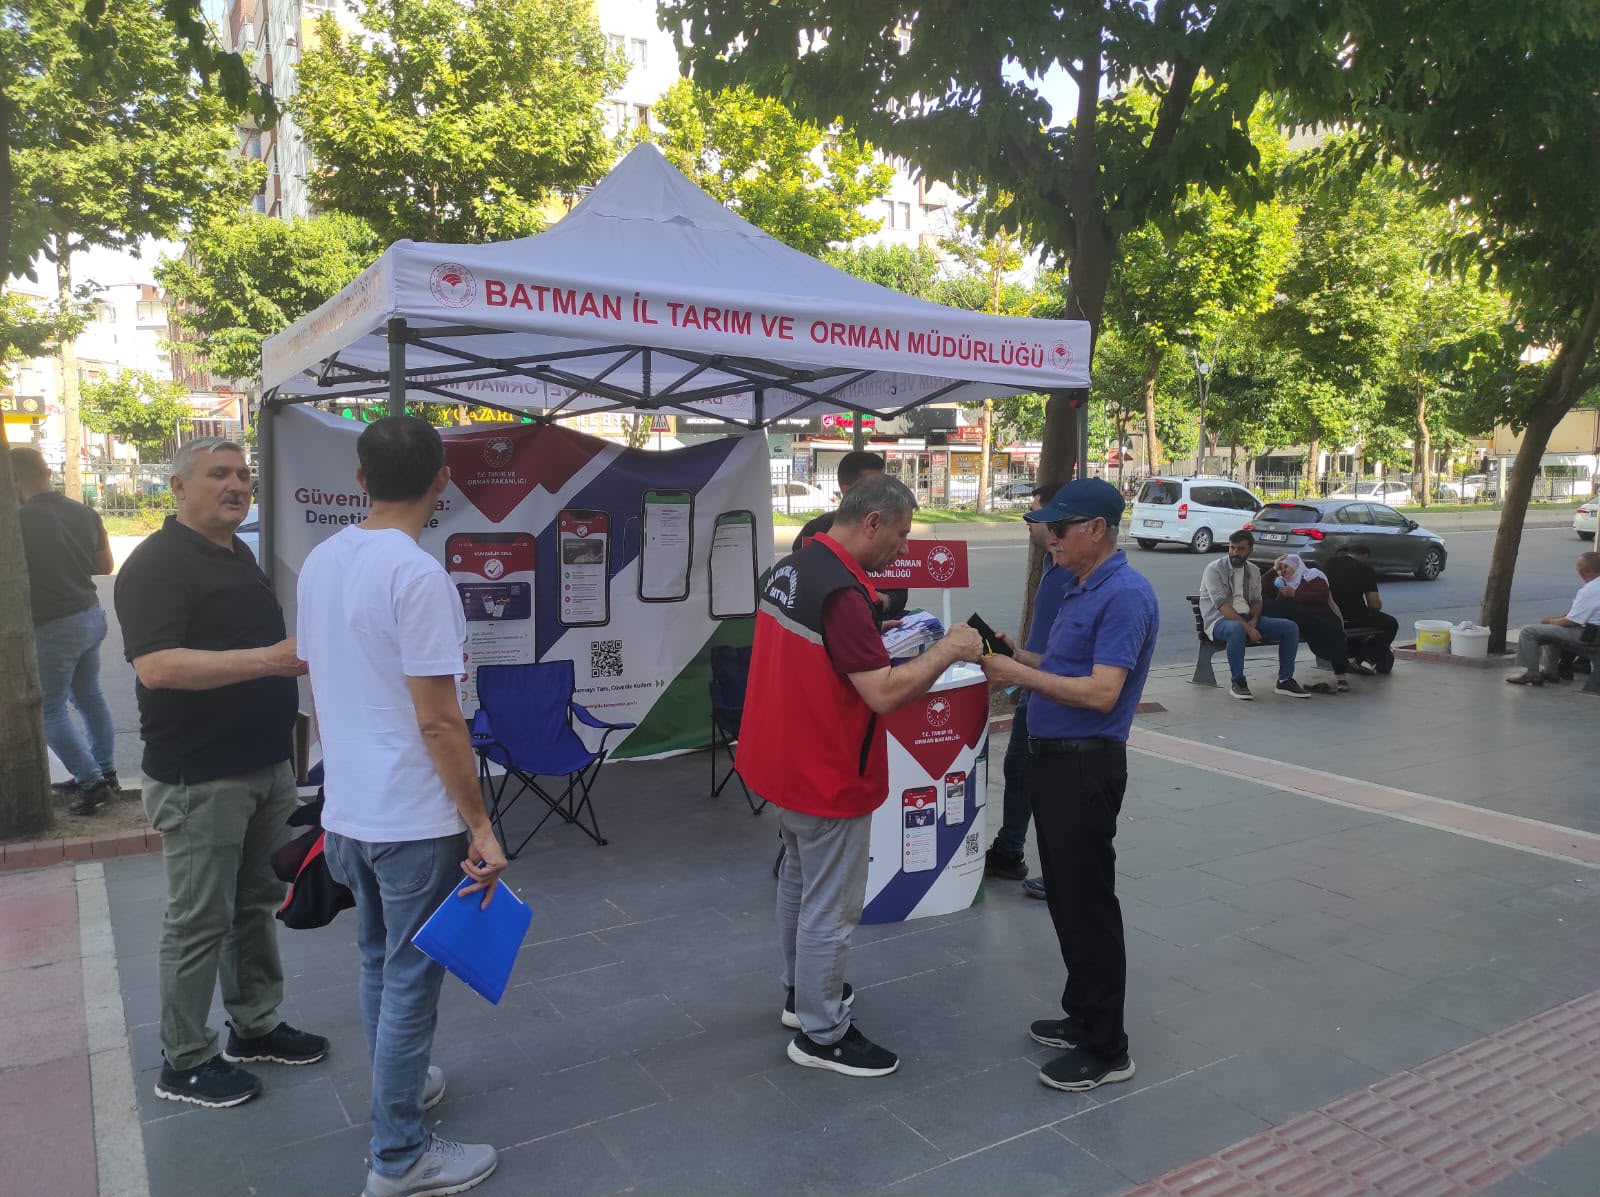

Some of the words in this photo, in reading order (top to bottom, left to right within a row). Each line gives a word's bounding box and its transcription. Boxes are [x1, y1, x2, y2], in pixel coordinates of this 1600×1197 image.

[485, 280, 622, 321] BATMAN
[633, 291, 658, 325] İL
[667, 303, 752, 336] TARIM
[760, 314, 794, 341] VE
[810, 320, 900, 352] ORMAN
[907, 331, 1044, 369] MÜDÜRLÜĞÜ
[894, 559, 922, 567] ORMAN
